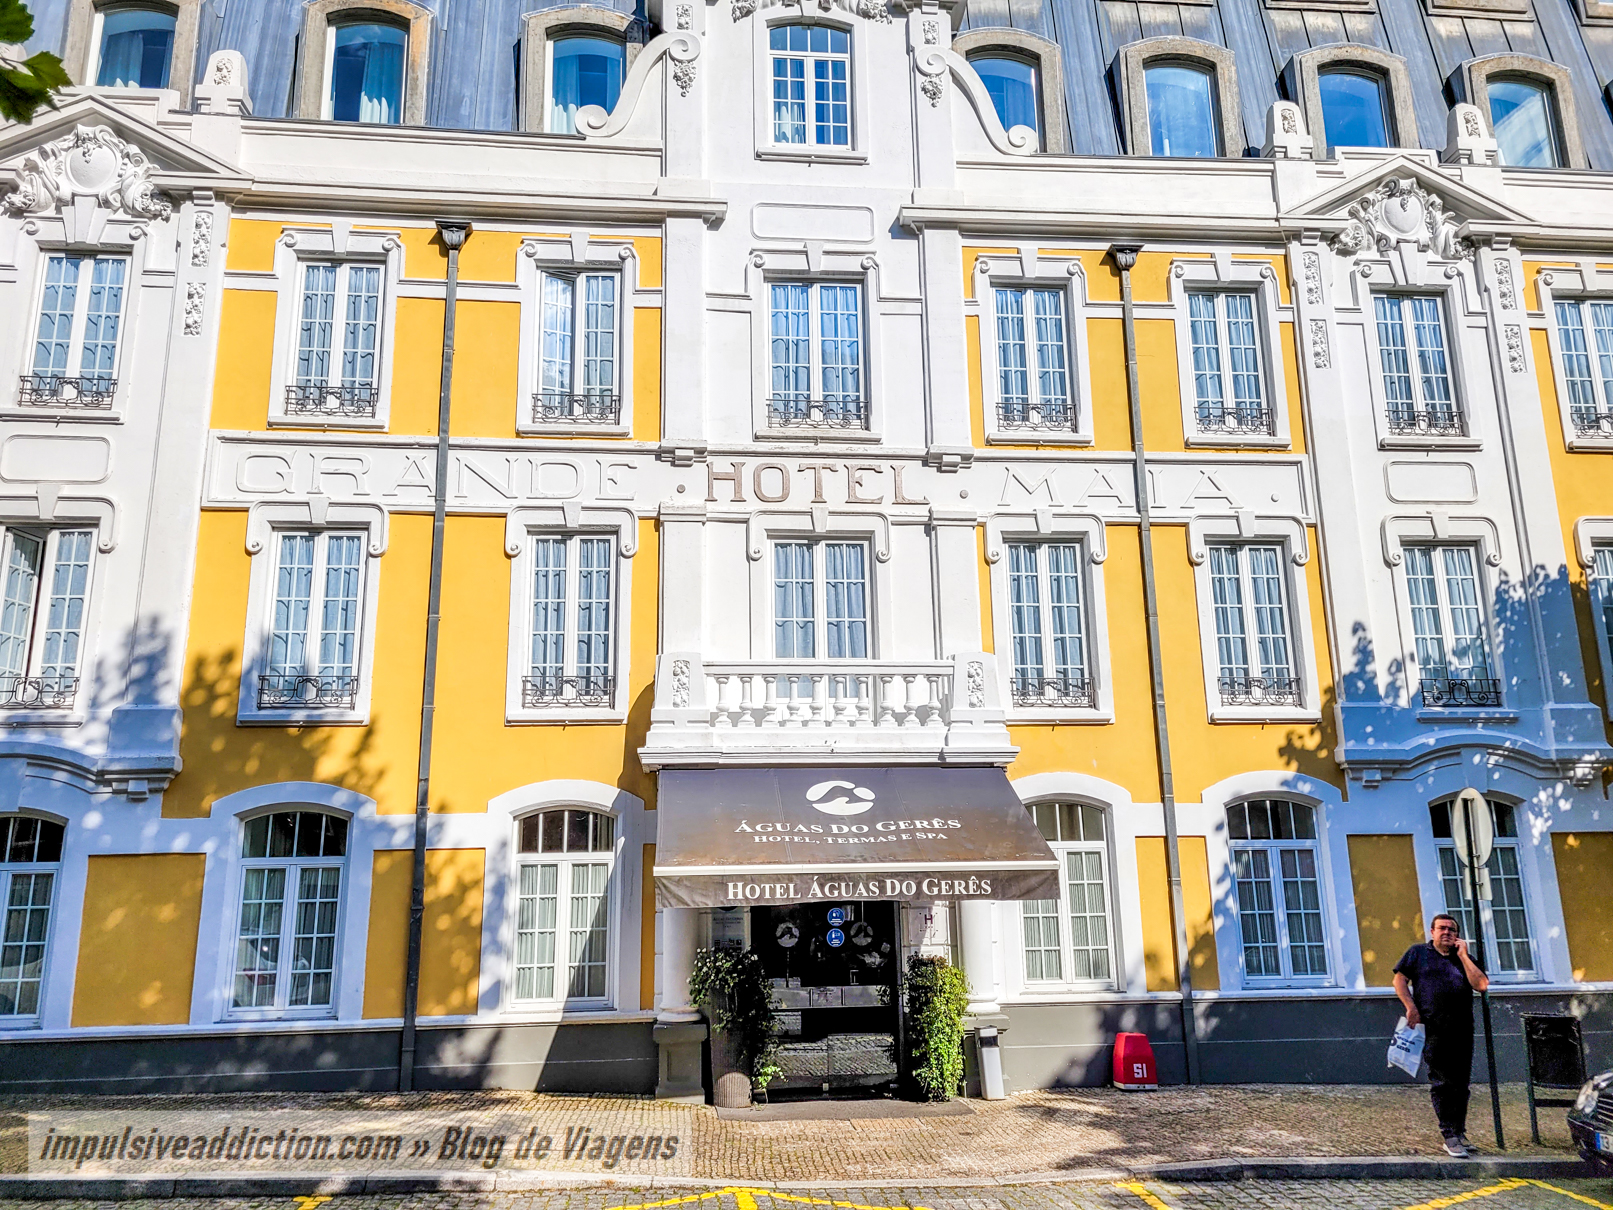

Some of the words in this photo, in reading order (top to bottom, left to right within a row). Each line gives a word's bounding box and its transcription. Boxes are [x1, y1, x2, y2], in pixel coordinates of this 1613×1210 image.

[235, 450, 638, 500] GRANDE
[704, 461, 930, 505] HOTEL
[997, 465, 1244, 509] MAIA
[734, 819, 824, 834] ÁGUAS
[830, 823, 870, 834] DO
[875, 817, 963, 832] GERÊS
[753, 835, 821, 845] HOTEL,
[823, 834, 897, 844] TERMAS
[901, 833, 912, 841] E
[915, 831, 948, 841] SPA
[726, 881, 802, 900] HOTEL
[807, 875, 880, 899] ÁGUAS
[885, 879, 918, 897] DO
[922, 875, 993, 896] GERÊS
[924, 914, 933, 924] H
